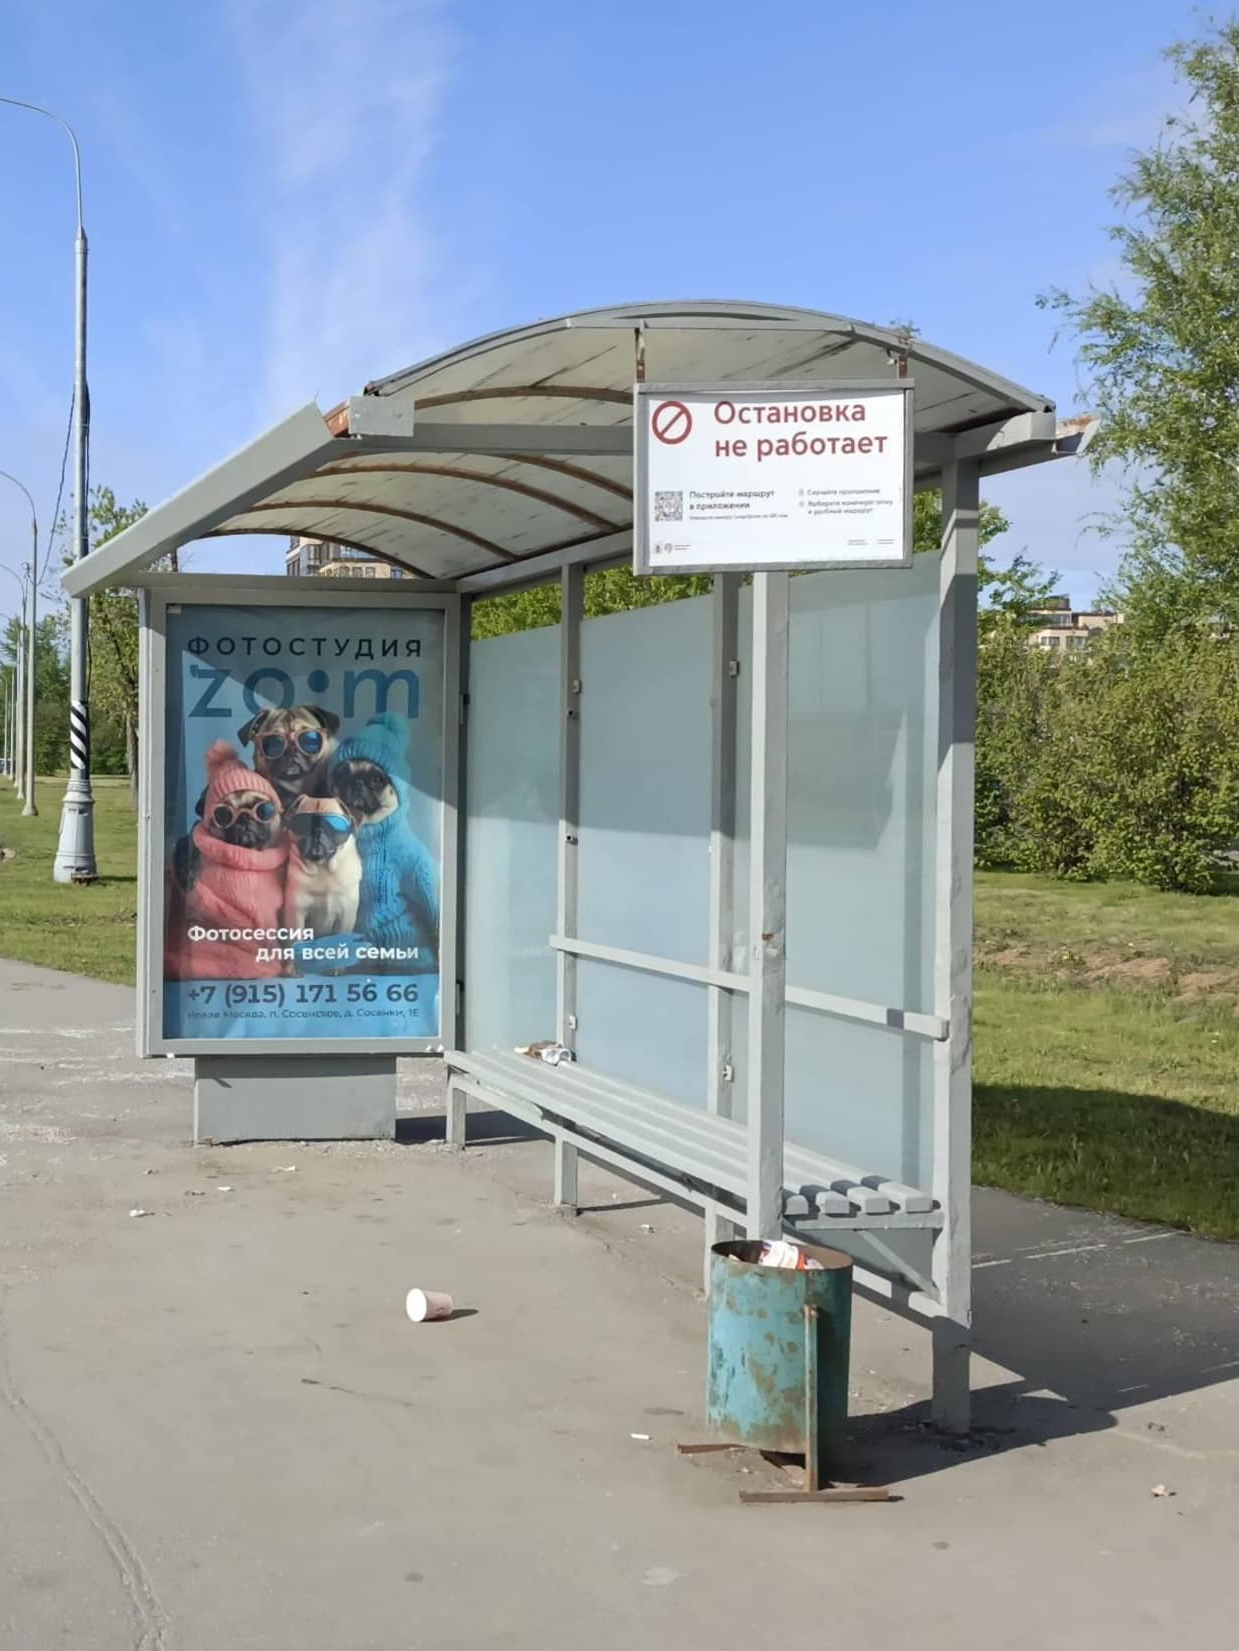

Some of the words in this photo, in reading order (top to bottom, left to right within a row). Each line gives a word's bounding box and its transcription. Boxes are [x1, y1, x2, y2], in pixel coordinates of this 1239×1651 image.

[714, 400, 865, 424] Остановка
[715, 438, 747, 457] не
[757, 432, 888, 462] работает
[689, 490, 734, 499] Постройте
[736, 490, 775, 499] маршрут
[696, 502, 750, 511] приложении
[187, 635, 421, 660] ФОТОСТУДИЯ
[187, 925, 314, 942] Фотосессия
[255, 947, 295, 963] для
[302, 943, 349, 960] всей
[355, 946, 419, 960] семьи
[187, 985, 216, 1003] +7
[224, 984, 285, 1008] (915)
[295, 984, 337, 1003] 171
[347, 983, 378, 1002] 56
[386, 983, 419, 1002] 66
